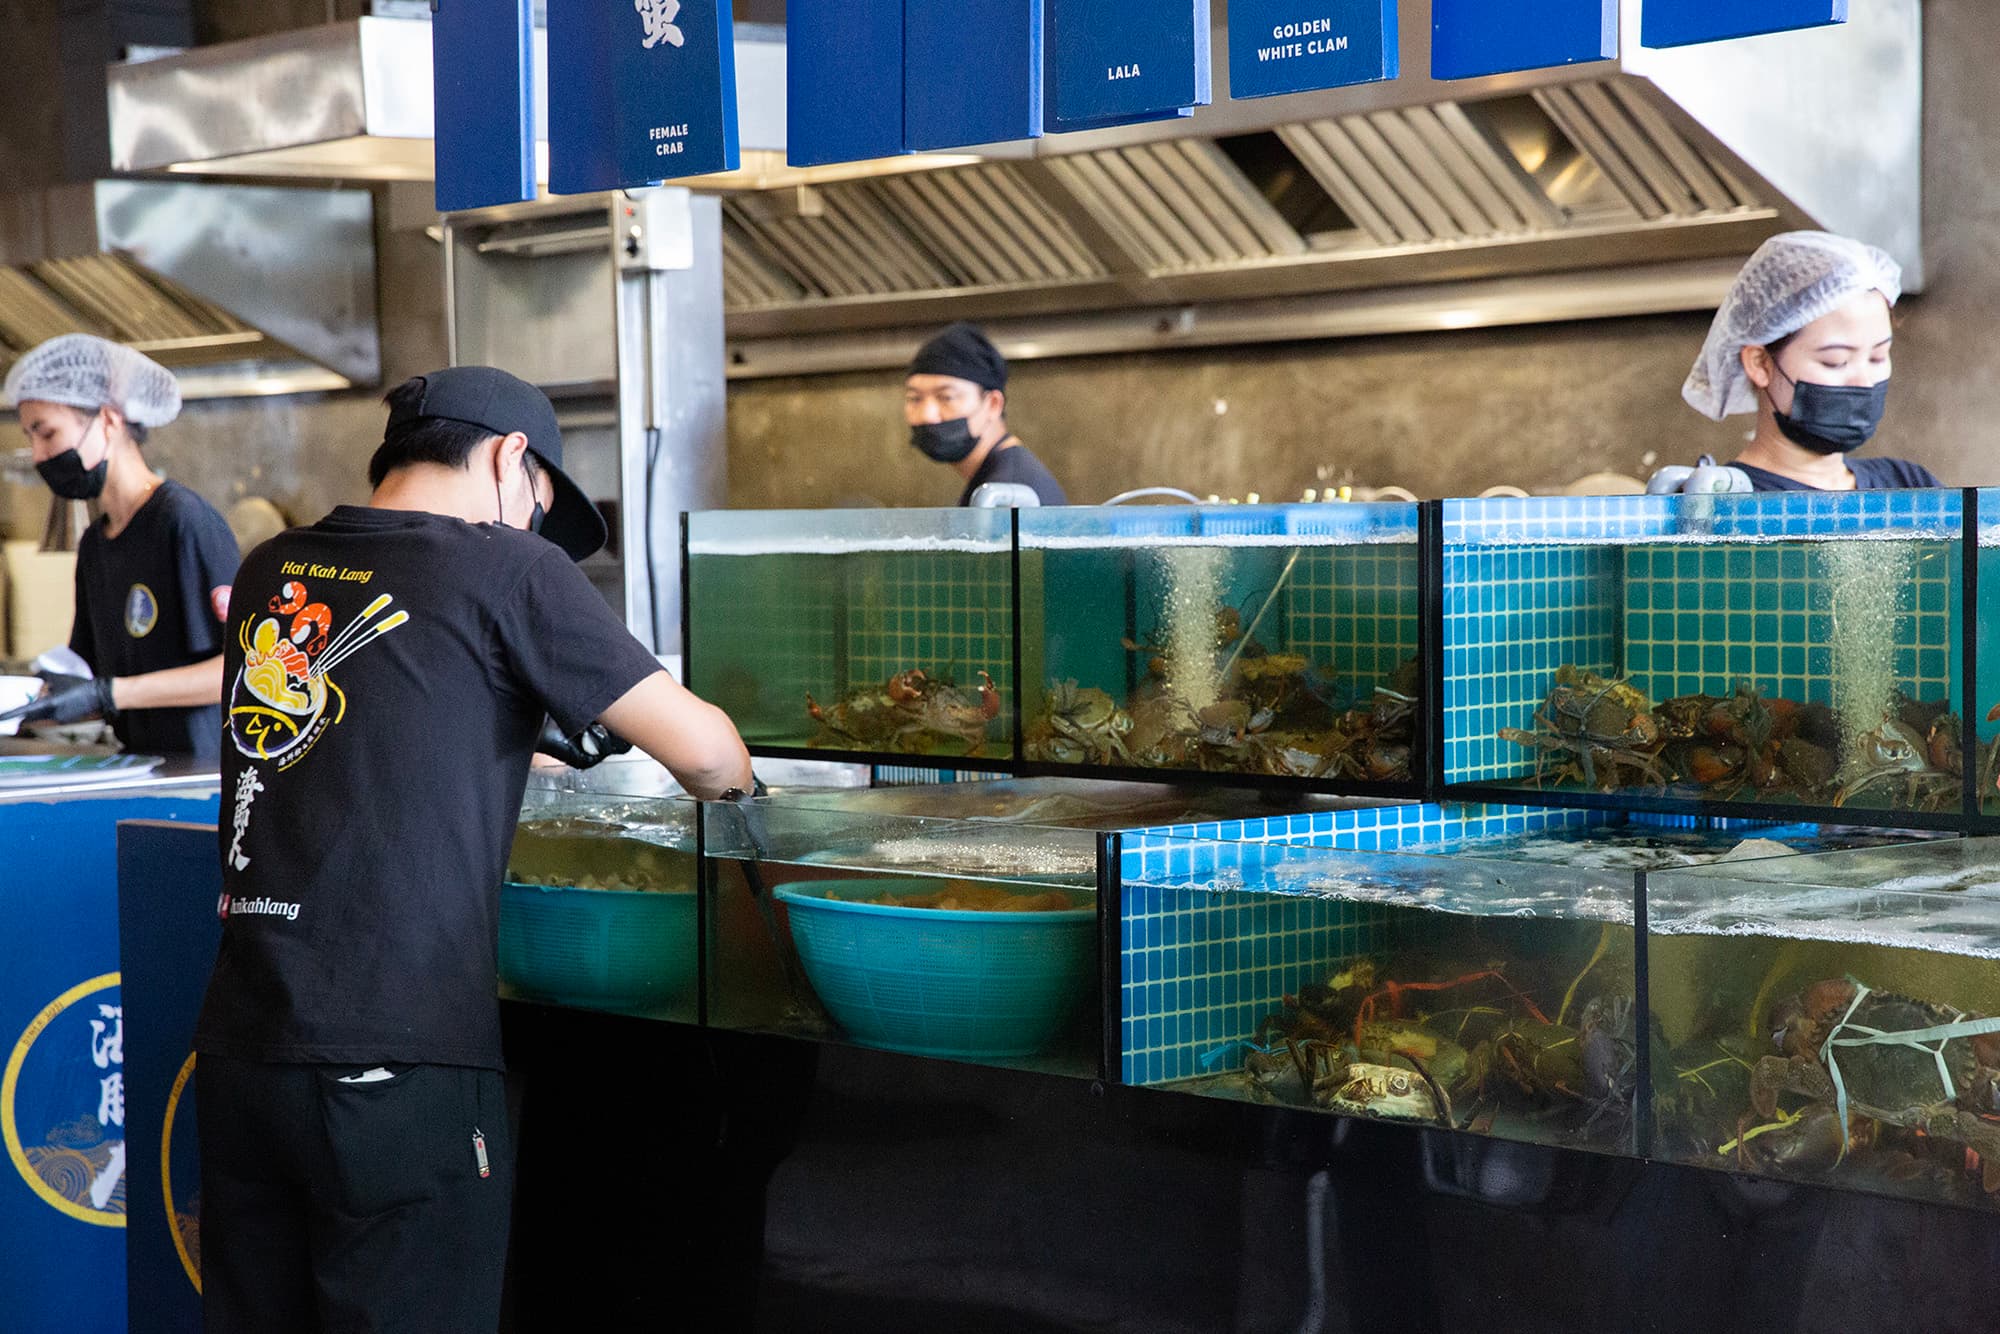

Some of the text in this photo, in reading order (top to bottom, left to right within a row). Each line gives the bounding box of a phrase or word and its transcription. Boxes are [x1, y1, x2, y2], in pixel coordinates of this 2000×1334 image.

[1273, 18, 1331, 39] GOLDEN
[1258, 36, 1348, 61] WHITE CLAM
[1108, 63, 1140, 80] LALA
[649, 123, 689, 140] FEMALE
[656, 141, 684, 156] CRAB
[281, 561, 374, 583] Hai Kah Lang
